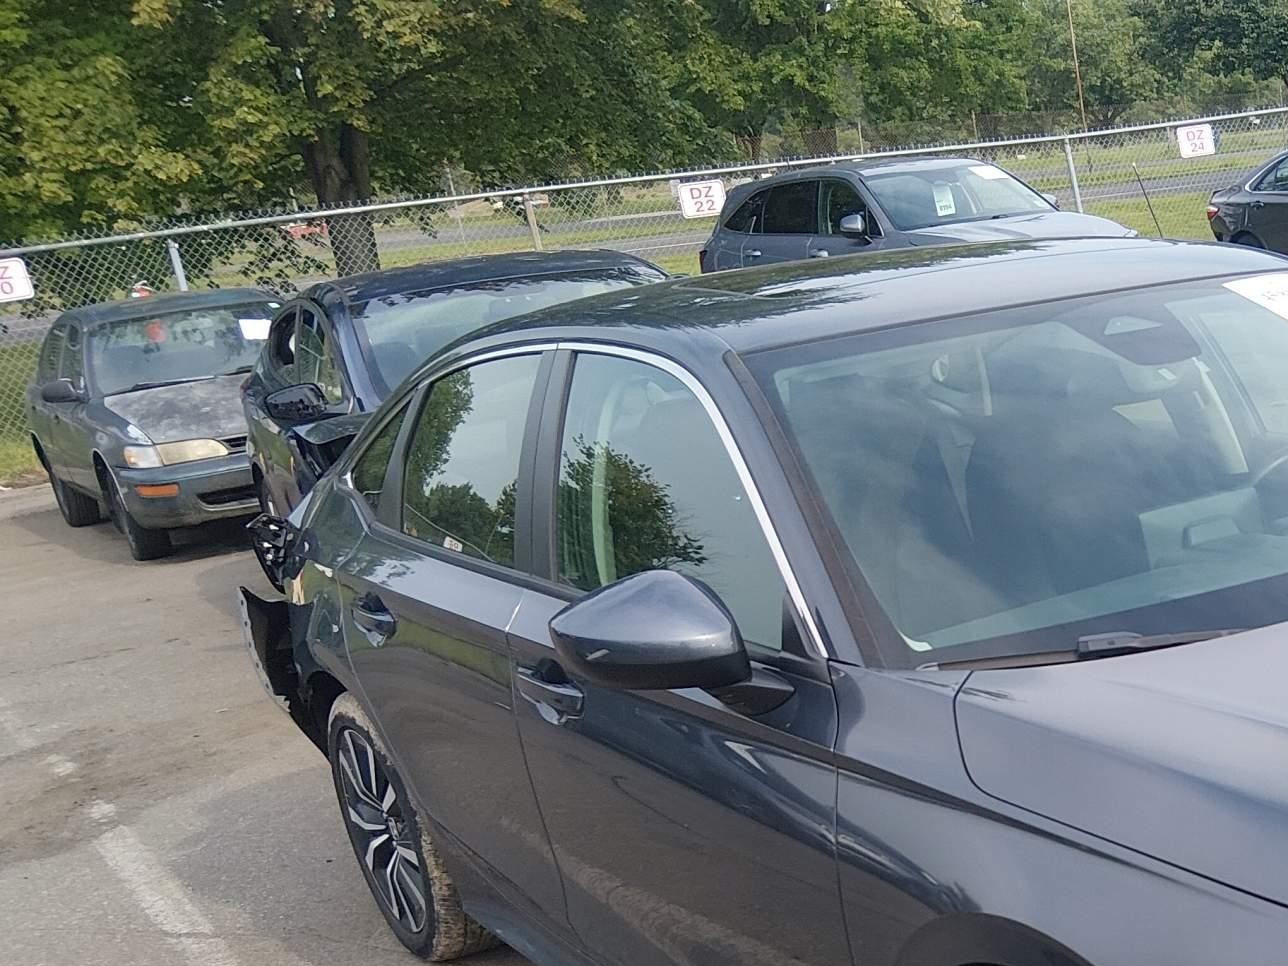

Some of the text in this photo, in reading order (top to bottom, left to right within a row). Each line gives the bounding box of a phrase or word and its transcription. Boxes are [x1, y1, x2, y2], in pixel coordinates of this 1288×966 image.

[1186, 129, 1204, 141] DZ
[690, 186, 714, 199] DZ
[694, 199, 716, 212] 22
